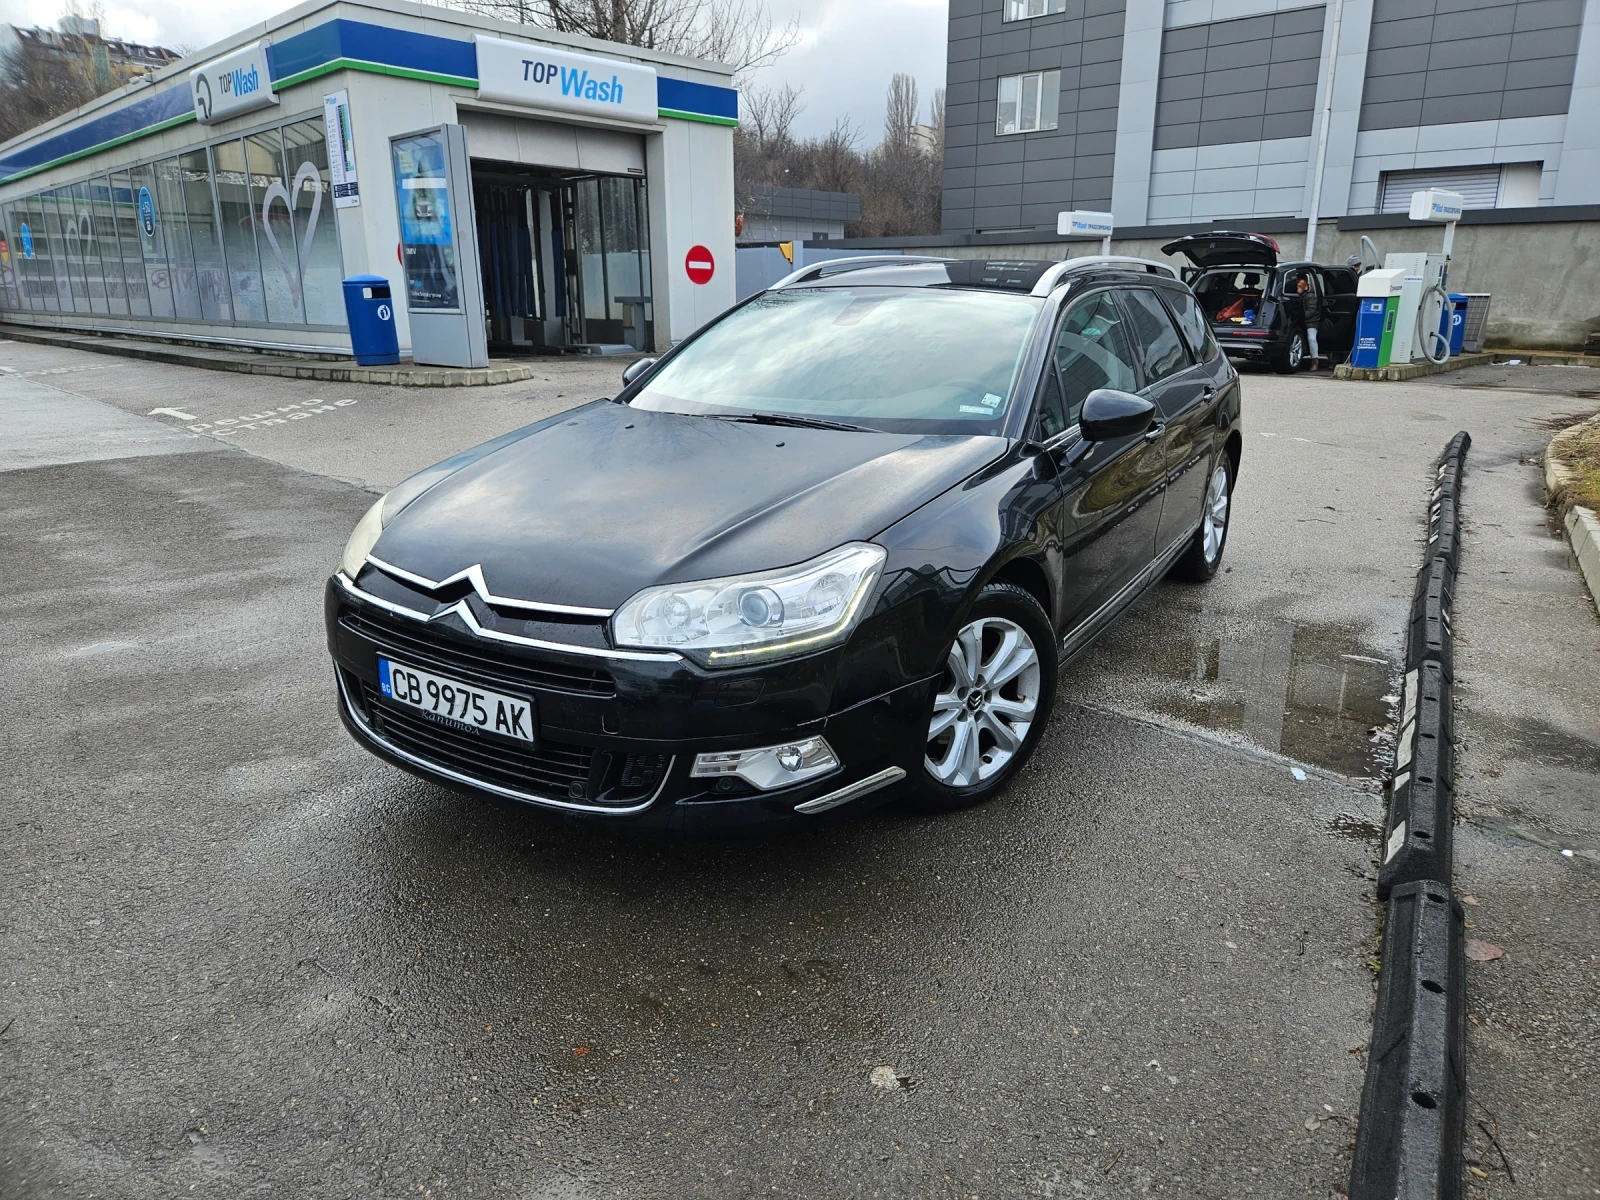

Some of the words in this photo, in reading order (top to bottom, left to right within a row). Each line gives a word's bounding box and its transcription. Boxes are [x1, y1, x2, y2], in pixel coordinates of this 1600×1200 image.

[218, 72, 232, 94] TOP
[231, 63, 259, 97] Wash
[521, 59, 558, 84] TOP
[560, 66, 623, 104] Wash
[381, 682, 391, 694] BG
[392, 668, 423, 705] CB
[426, 679, 488, 726] 9975
[495, 699, 530, 740] AK
